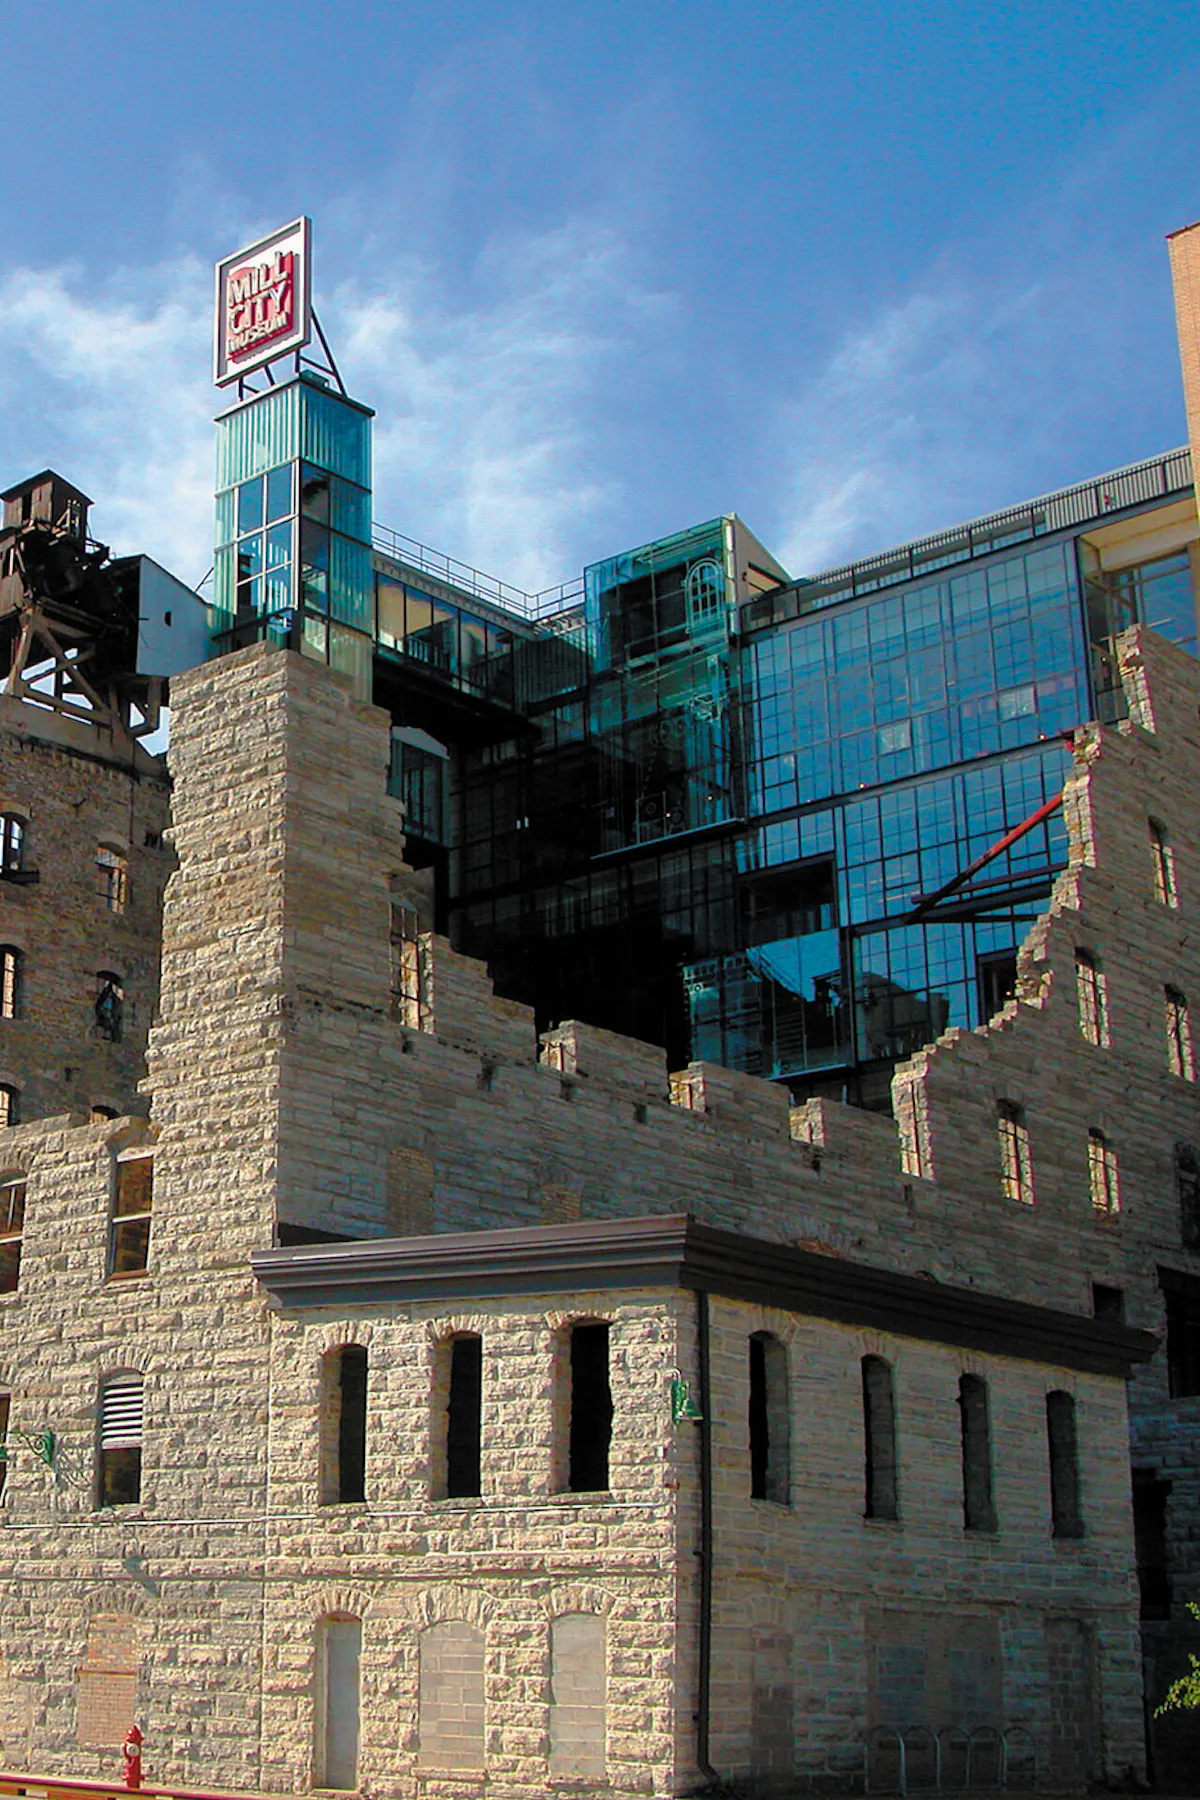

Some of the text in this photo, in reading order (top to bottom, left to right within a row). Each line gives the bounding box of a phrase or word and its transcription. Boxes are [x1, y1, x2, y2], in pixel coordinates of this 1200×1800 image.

[229, 251, 288, 306] MILL
[228, 311, 287, 353] MUSEUM
[230, 281, 287, 333] CITY
